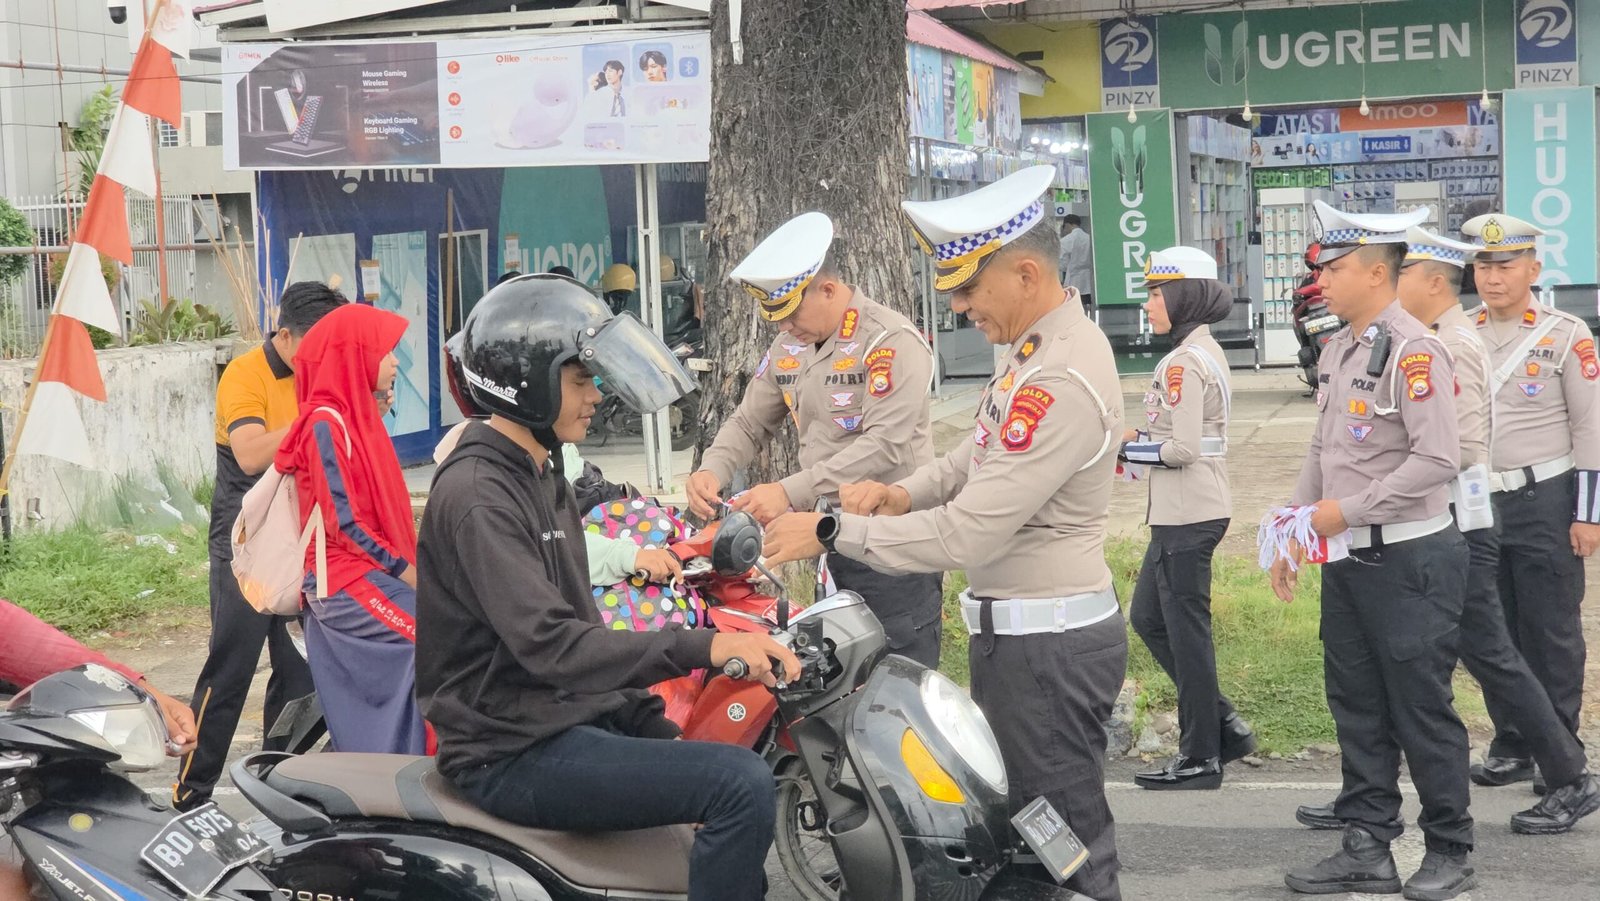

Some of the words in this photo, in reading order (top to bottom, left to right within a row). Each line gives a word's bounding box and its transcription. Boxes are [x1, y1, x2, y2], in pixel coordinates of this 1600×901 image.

[1258, 22, 1471, 70] UGREEN
[383, 70, 407, 78] Gaming
[1521, 67, 1573, 83] PINZY
[1106, 90, 1155, 106] PINZY
[363, 117, 393, 125] Keyboard
[393, 116, 418, 125] Gaming
[1274, 113, 1325, 136] ATAS
[379, 125, 405, 135] Lighting
[1371, 140, 1401, 151] KASIR
[866, 349, 893, 364] POLDA
[1401, 354, 1430, 368] POLDA
[824, 372, 864, 385] POLRI
[1350, 377, 1377, 392] POLRI
[153, 831, 194, 868] BD
[185, 809, 233, 839] 5975
